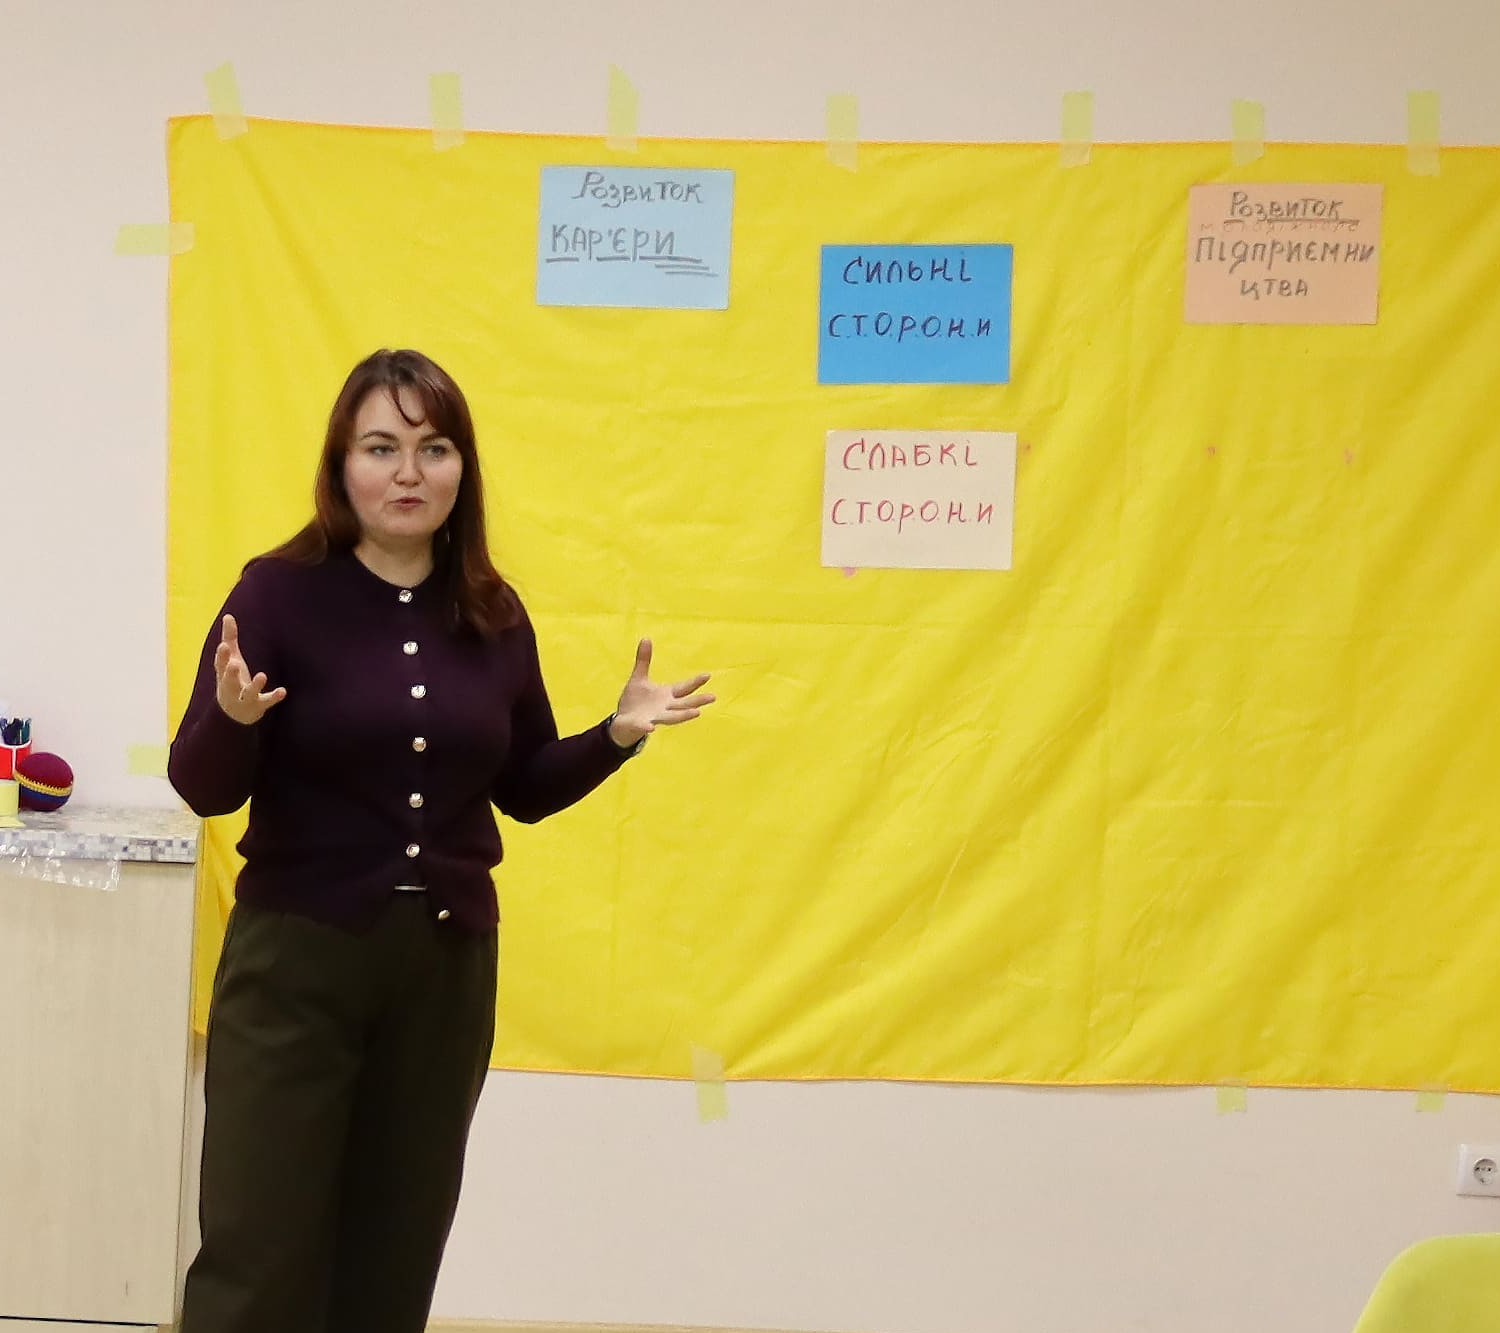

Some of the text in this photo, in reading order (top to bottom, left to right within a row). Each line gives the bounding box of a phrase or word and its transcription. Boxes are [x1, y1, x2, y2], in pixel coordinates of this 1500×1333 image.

[571, 171, 704, 208] Розвиток
[1230, 191, 1344, 221] Розвиток
[842, 252, 973, 285] СИЛЬНІ
[827, 312, 992, 343] СТОРОНИ
[842, 437, 979, 472] СЛАБКІ
[831, 498, 994, 534] СТОРОНИ
